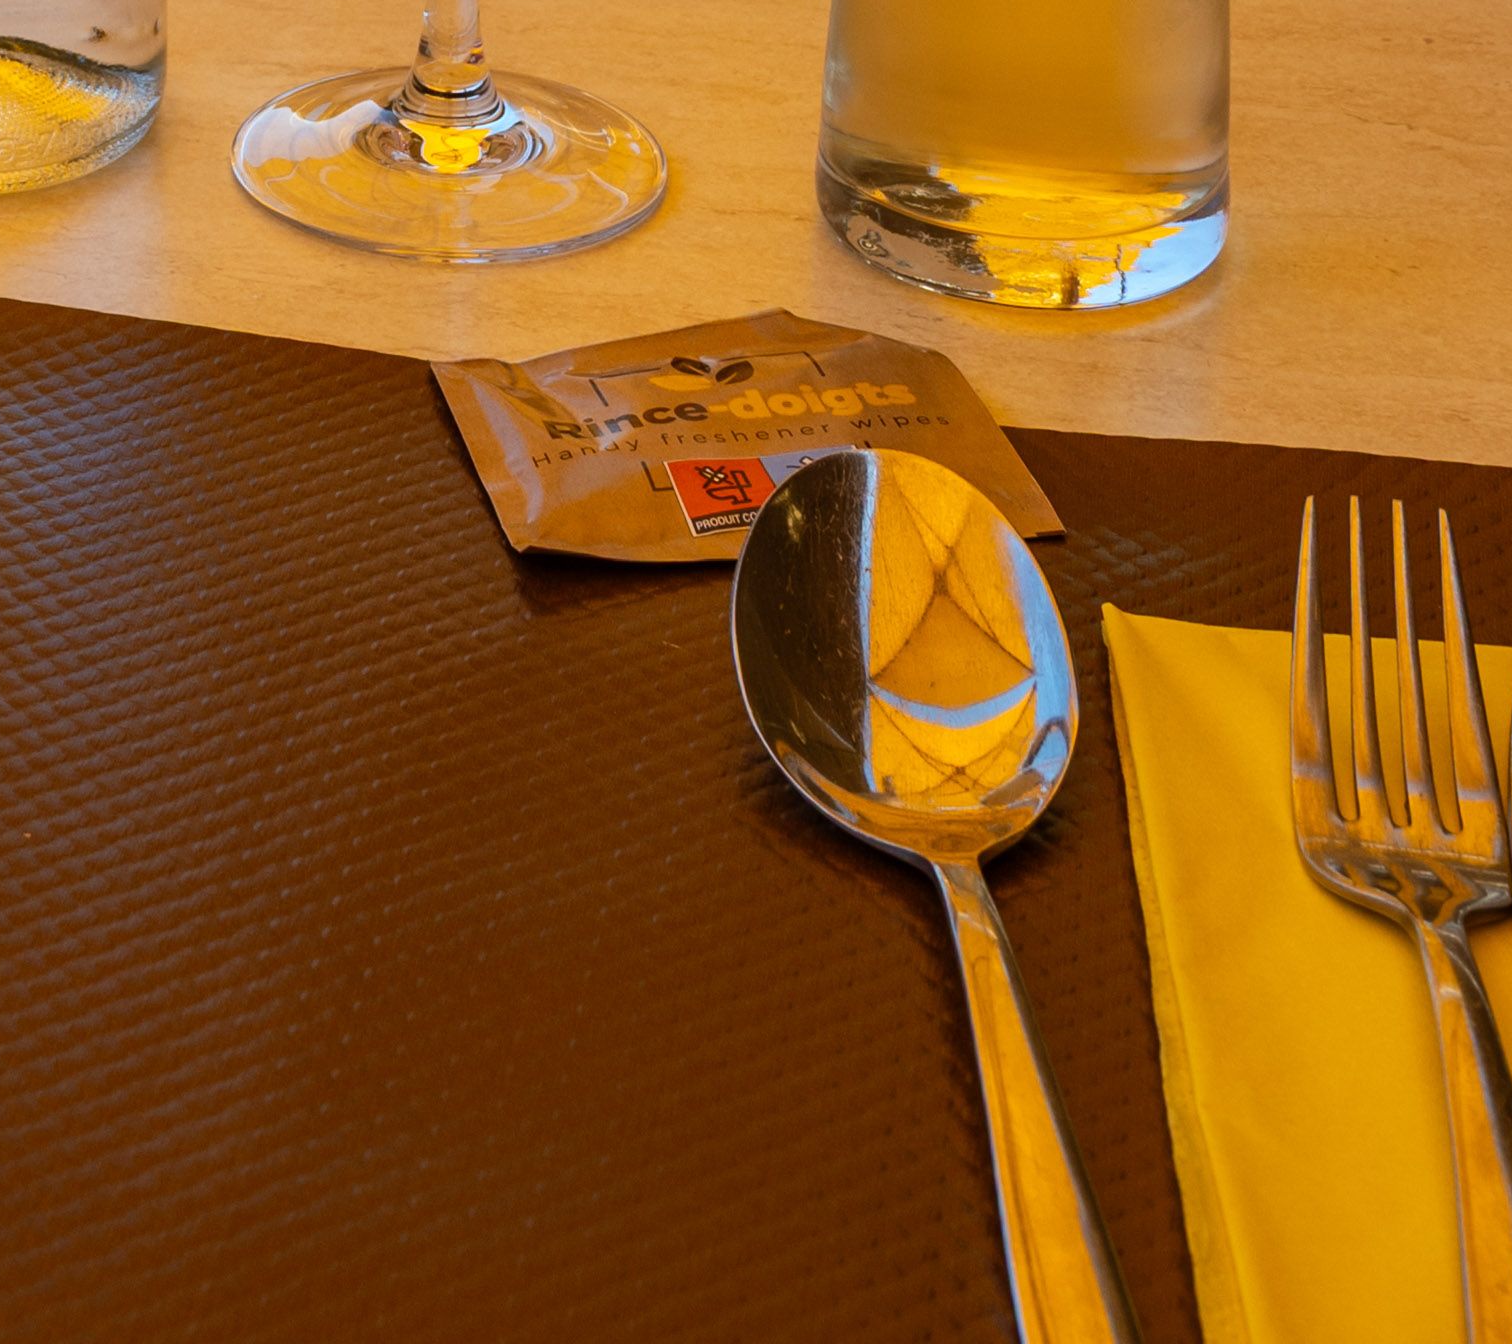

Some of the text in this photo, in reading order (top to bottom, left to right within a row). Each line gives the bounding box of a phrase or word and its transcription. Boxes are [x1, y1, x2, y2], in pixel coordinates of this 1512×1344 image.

[542, 381, 918, 440] Rince-doigts
[531, 413, 950, 468] Handy freshener wipes
[695, 513, 741, 531] PRODUIT
